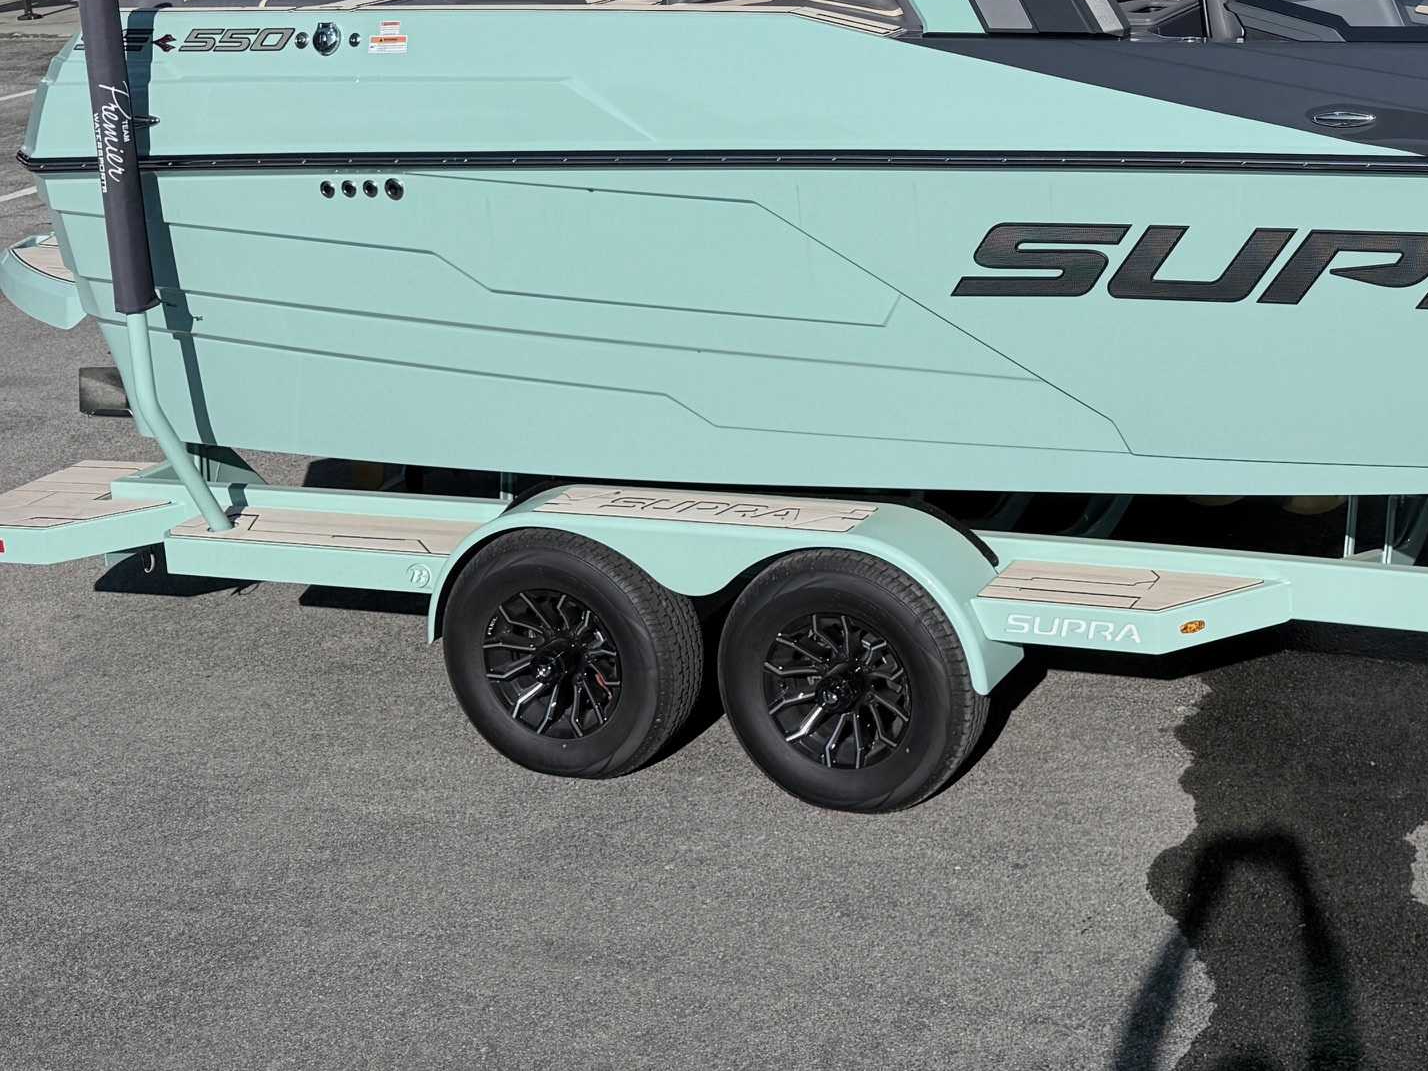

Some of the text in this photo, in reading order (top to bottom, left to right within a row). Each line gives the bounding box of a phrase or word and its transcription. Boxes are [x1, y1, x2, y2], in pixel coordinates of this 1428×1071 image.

[178, 27, 296, 52] 550
[98, 80, 133, 183] Premier
[121, 119, 131, 143] TEAM
[598, 496, 801, 521] SUPRA
[1005, 613, 1141, 644] SUPRA
